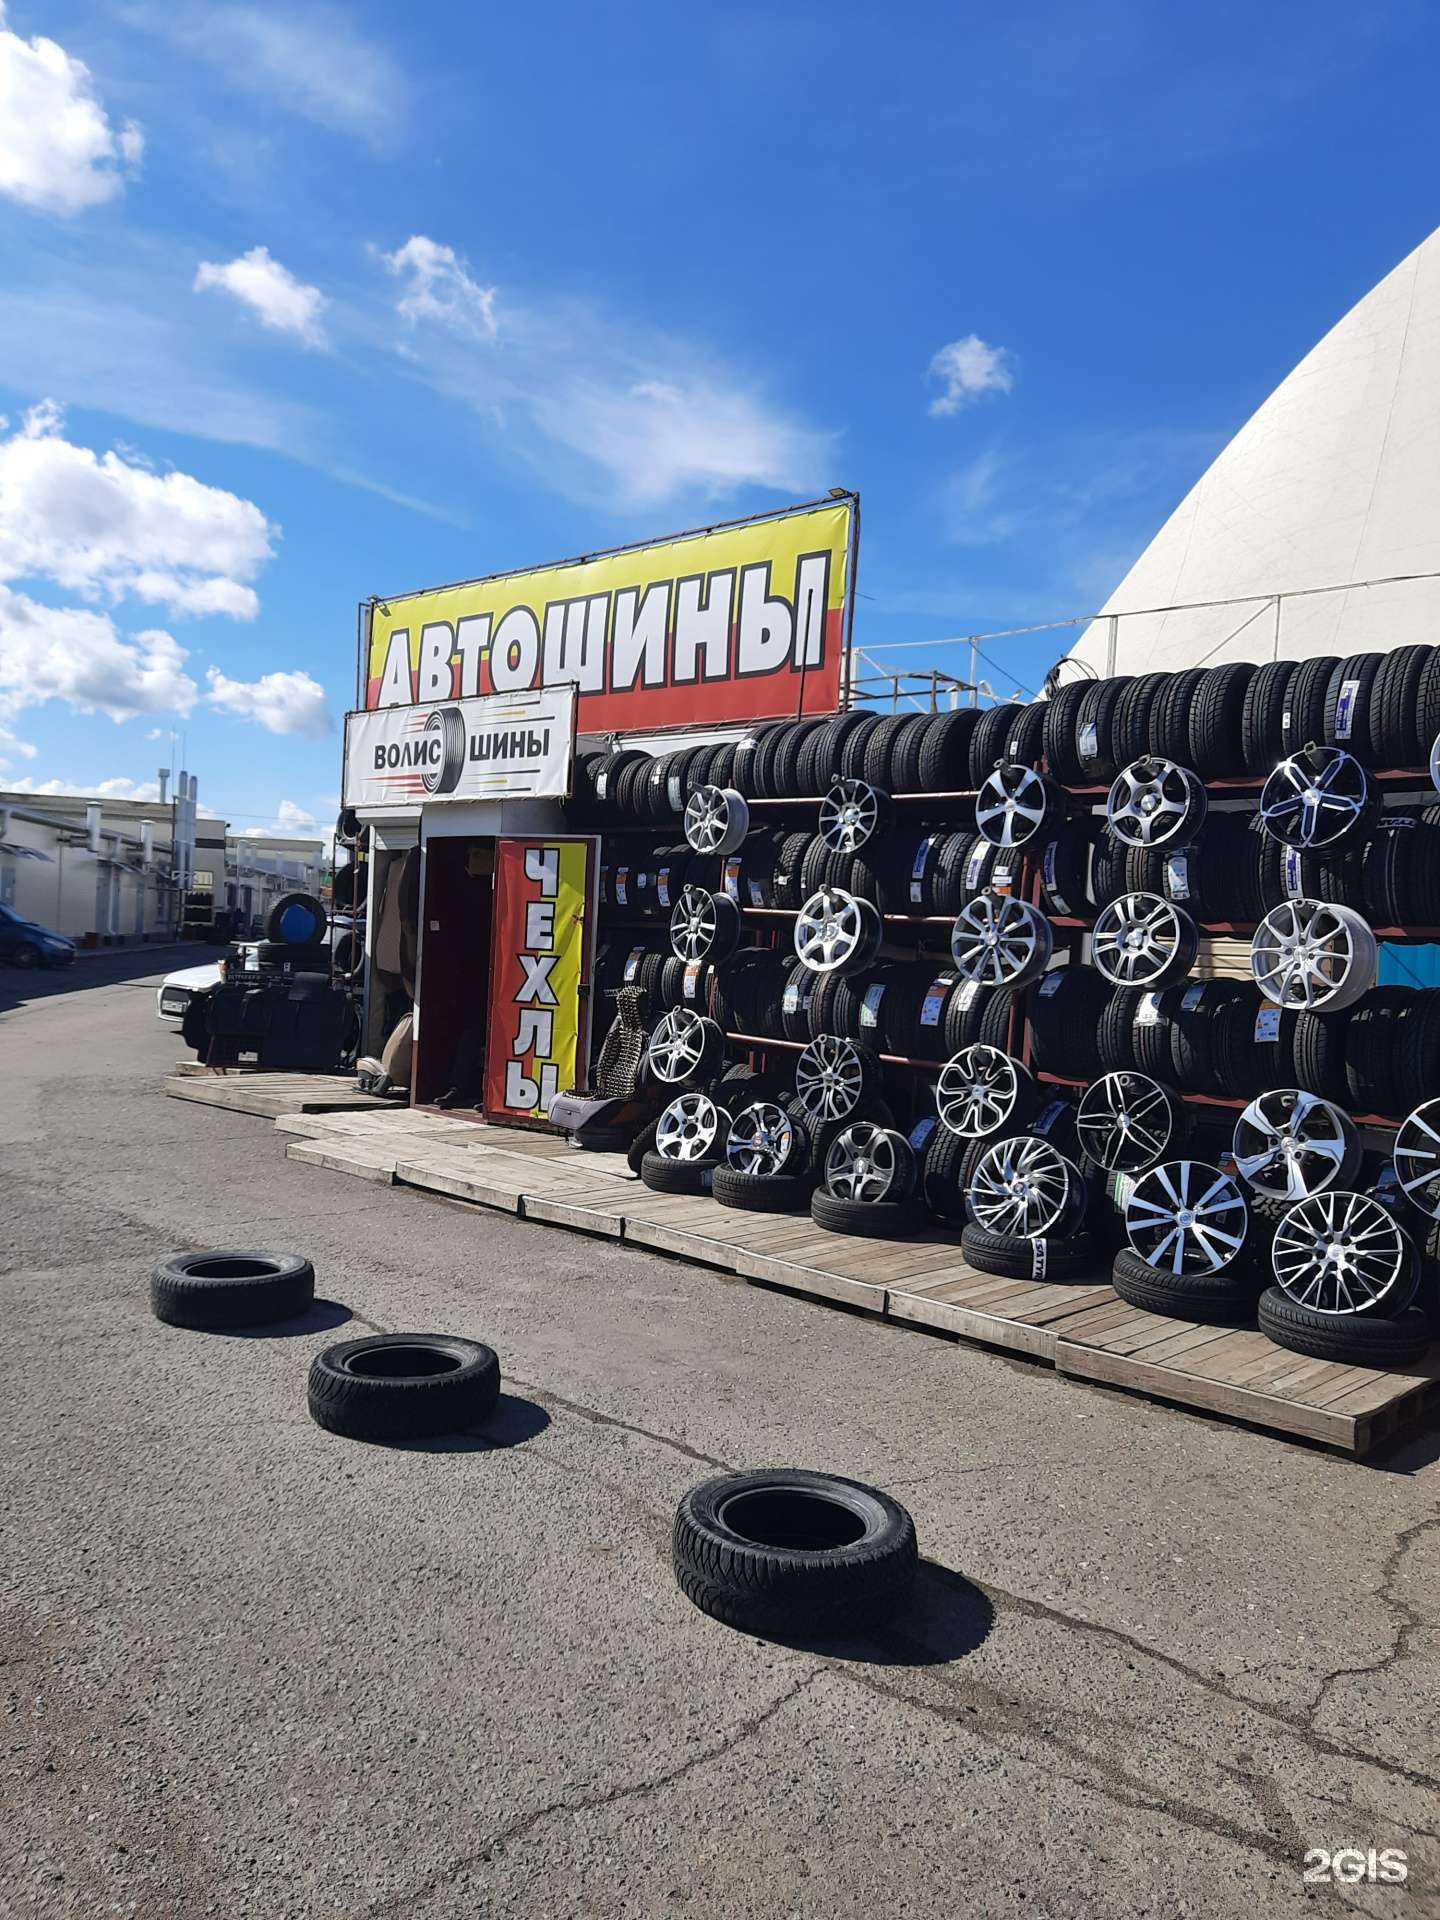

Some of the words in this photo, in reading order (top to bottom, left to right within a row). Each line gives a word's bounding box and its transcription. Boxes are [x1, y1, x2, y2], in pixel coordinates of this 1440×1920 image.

[377, 550, 832, 709] АВТОШИНЫ
[374, 738, 442, 770] ВОЛИС
[469, 728, 550, 762] ШИНЫ
[504, 848, 561, 1112] ЧЕХЛЫ
